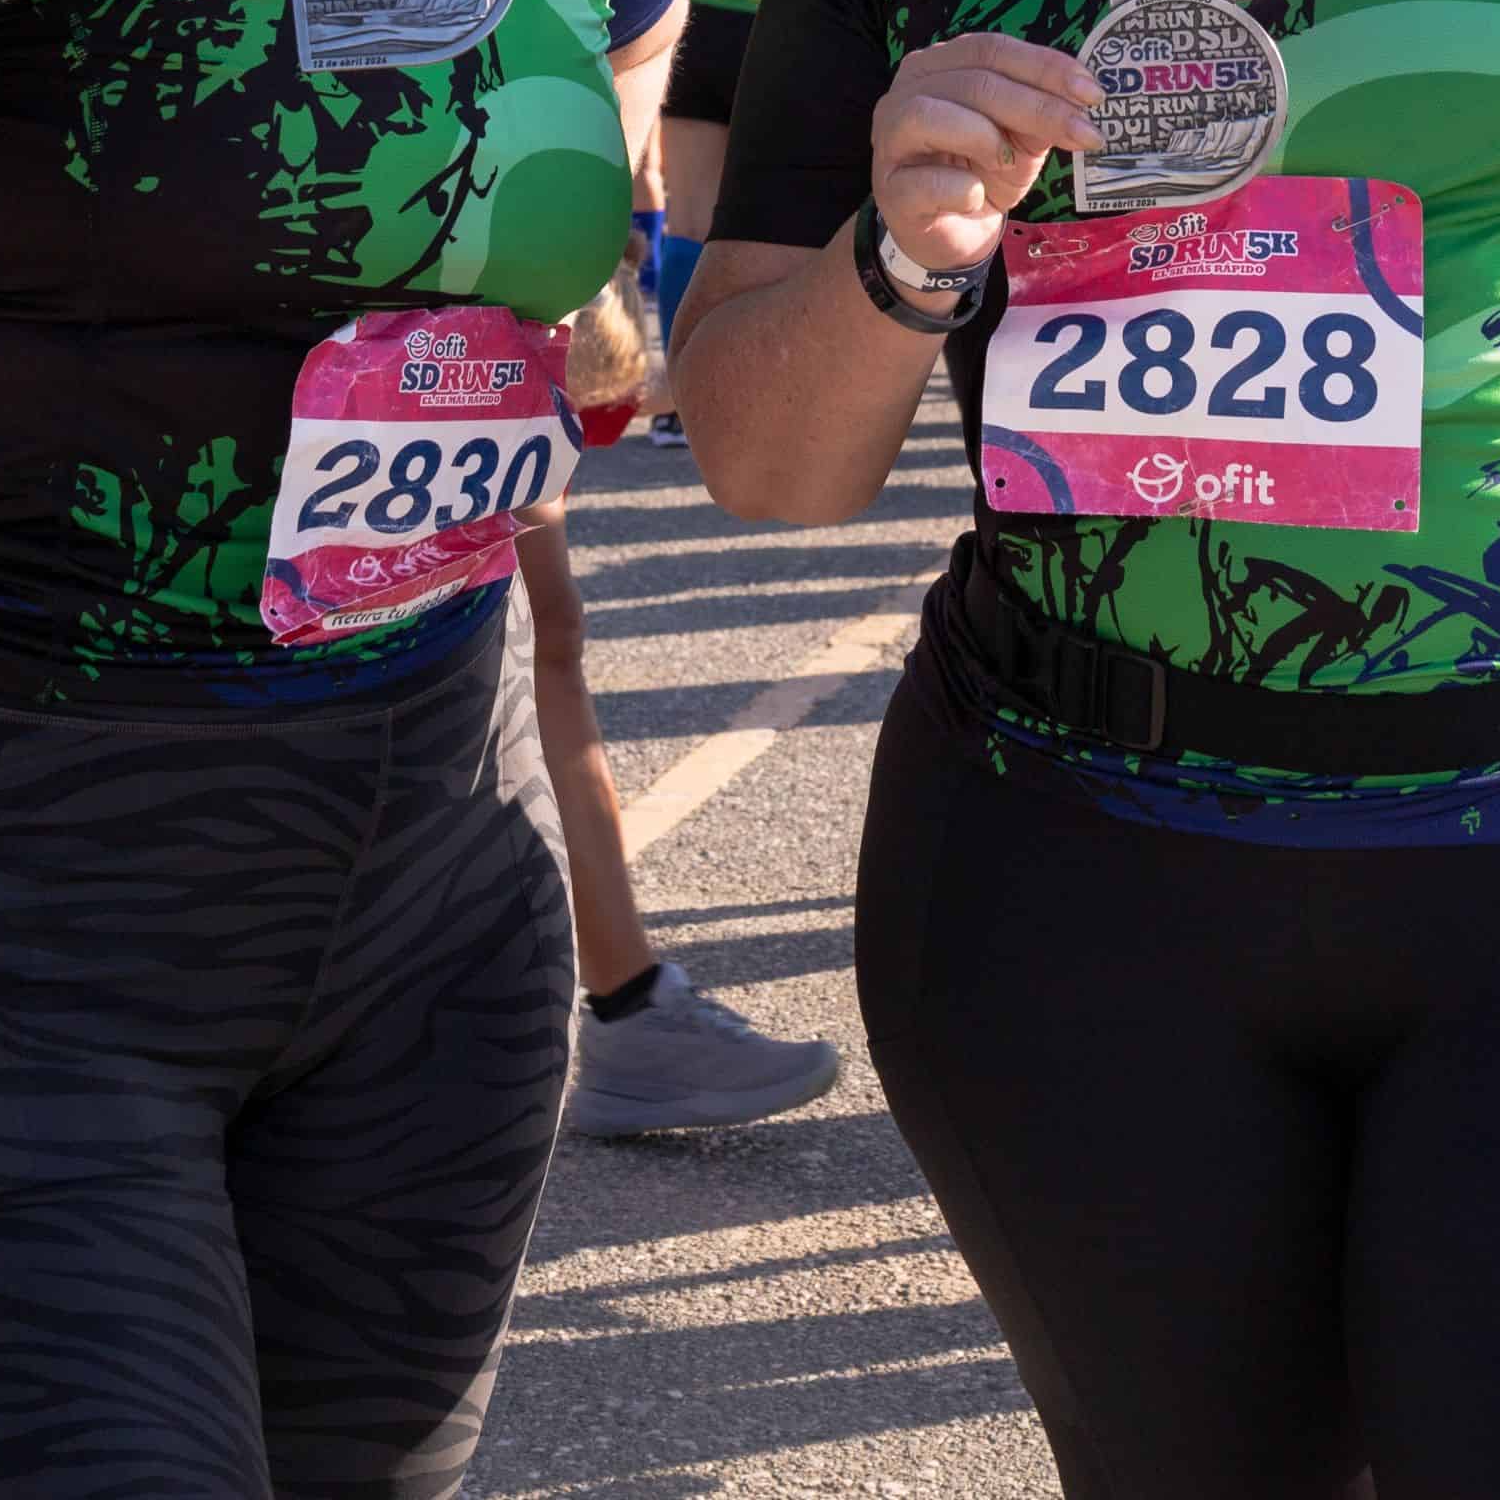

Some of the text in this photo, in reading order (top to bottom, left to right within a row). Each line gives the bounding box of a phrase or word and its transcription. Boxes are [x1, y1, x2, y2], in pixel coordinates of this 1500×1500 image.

[1129, 41, 1170, 61] ofit
[1098, 60, 1261, 95] SDRUN5K
[1166, 214, 1207, 238] ofit
[1128, 230, 1298, 273] SDRUN5K
[1187, 263, 1211, 275] MÁS
[1214, 262, 1266, 276] RÁPIDO
[434, 334, 467, 357] ofit
[400, 361, 525, 392] SDRUN5K
[1029, 308, 1379, 423] 2828
[467, 391, 502, 406] RÁPIDO
[297, 434, 553, 534] 2830
[1195, 463, 1275, 506] ofit
